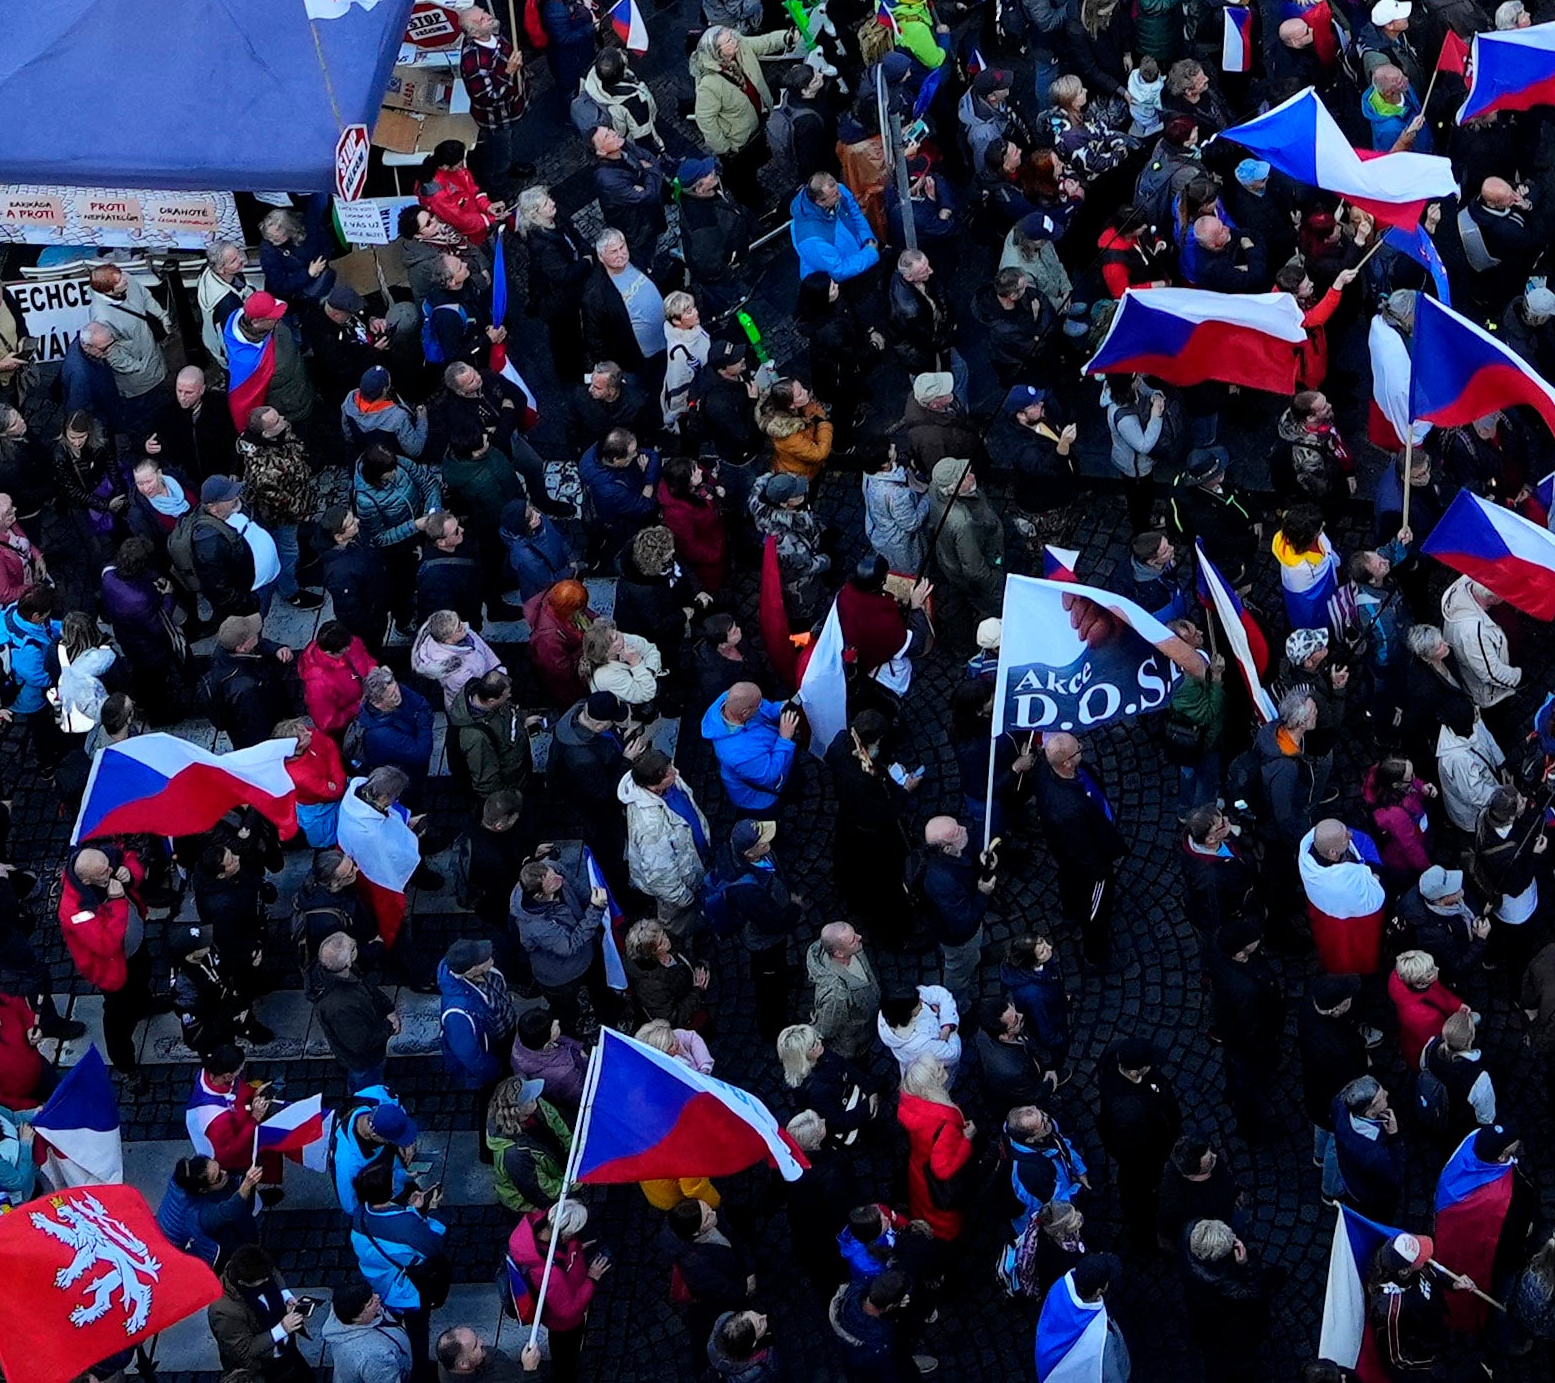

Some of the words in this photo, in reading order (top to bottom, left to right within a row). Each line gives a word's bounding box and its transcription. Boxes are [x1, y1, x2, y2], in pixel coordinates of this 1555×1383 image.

[409, 11, 442, 29] STOP
[337, 129, 358, 177] STOP
[6, 210, 16, 219] A
[19, 210, 55, 220] PROTI
[89, 202, 126, 213] PROTI
[15, 280, 92, 313] ECHCE
[1014, 661, 1093, 695] Akce
